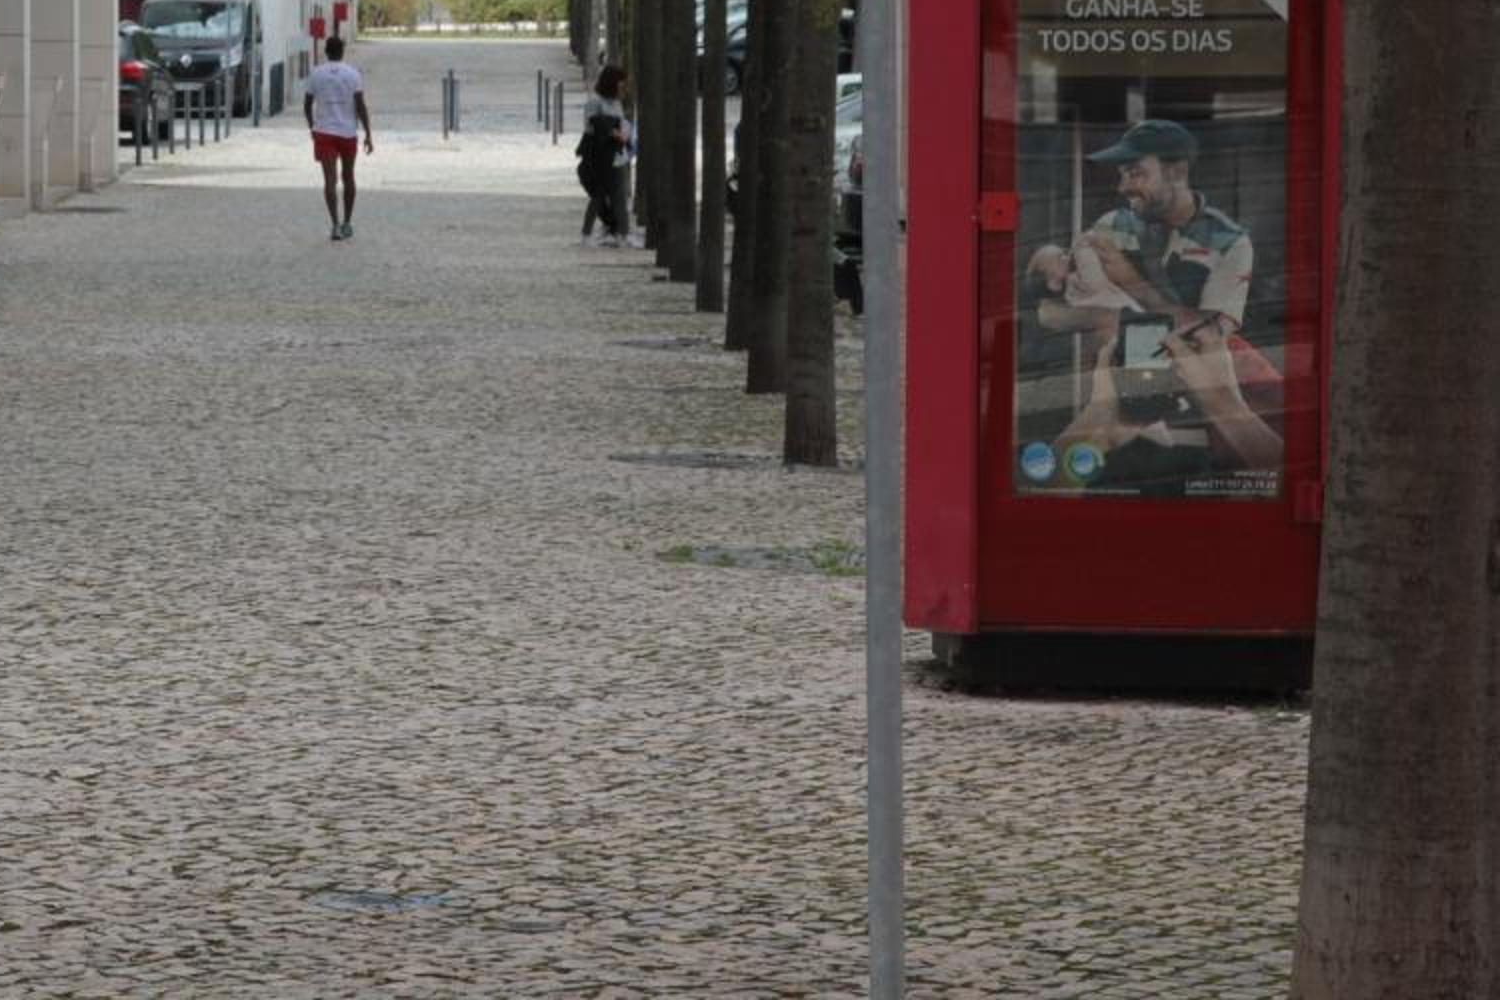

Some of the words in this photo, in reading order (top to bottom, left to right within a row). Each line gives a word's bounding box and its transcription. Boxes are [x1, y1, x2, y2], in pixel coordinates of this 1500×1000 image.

[1038, 29, 1125, 51] TODOS
[1131, 29, 1166, 51] OS
[1172, 29, 1233, 51] DIAS
